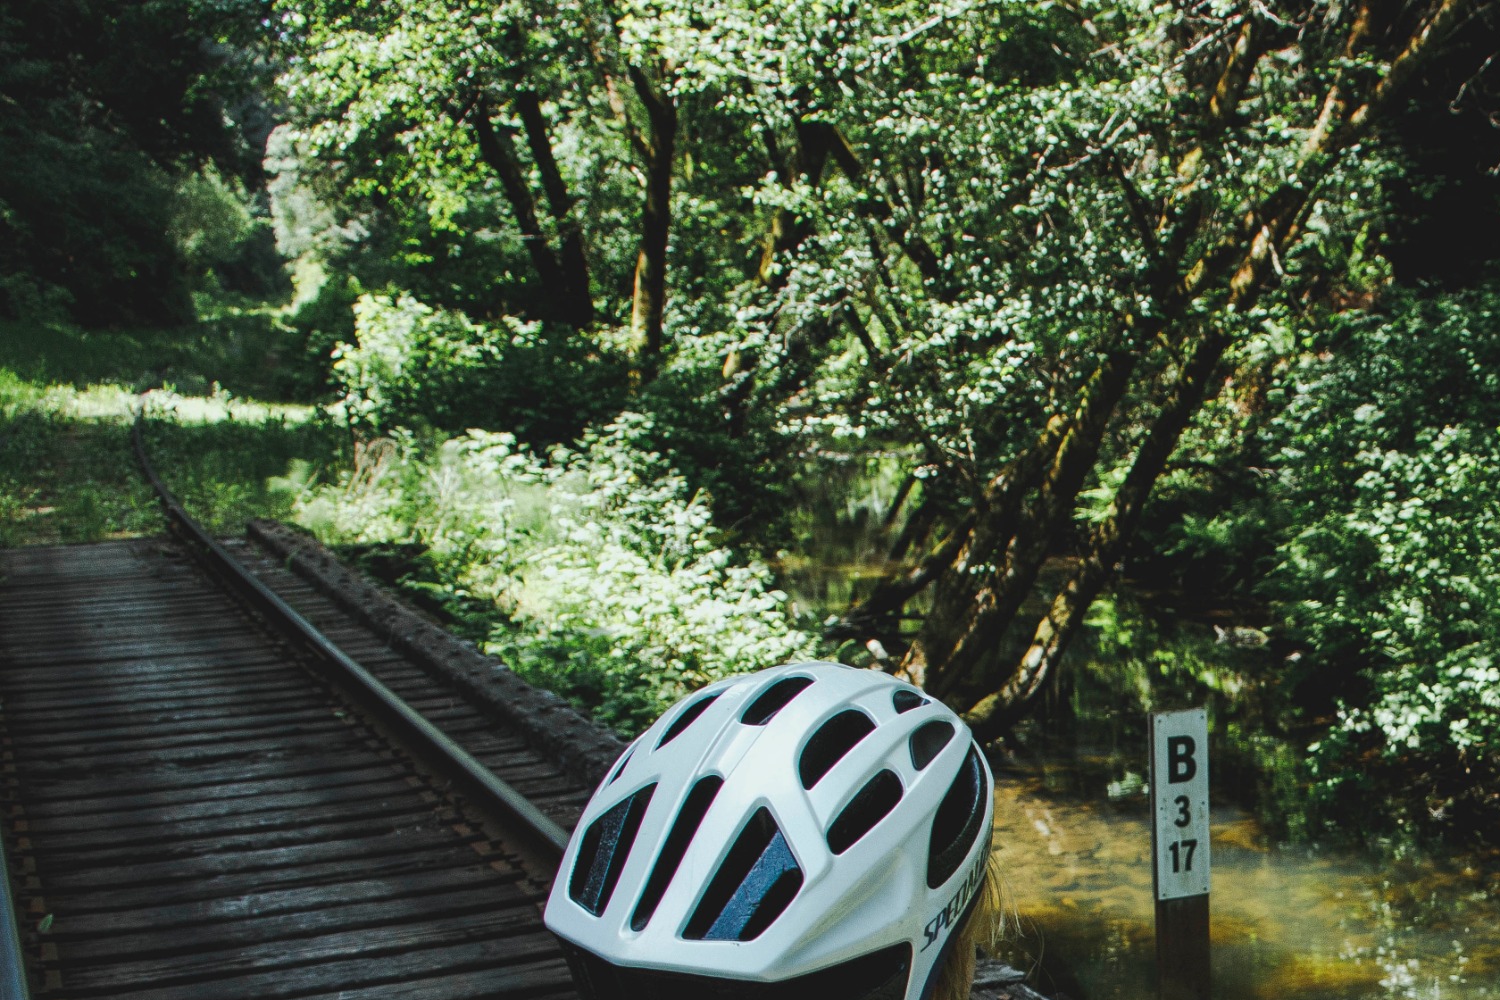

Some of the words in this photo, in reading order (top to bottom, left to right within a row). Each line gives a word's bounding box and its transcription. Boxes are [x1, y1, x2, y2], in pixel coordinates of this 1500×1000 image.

[1167, 735, 1197, 784] B
[1174, 795, 1191, 828] 3
[1168, 839, 1198, 873] 17
